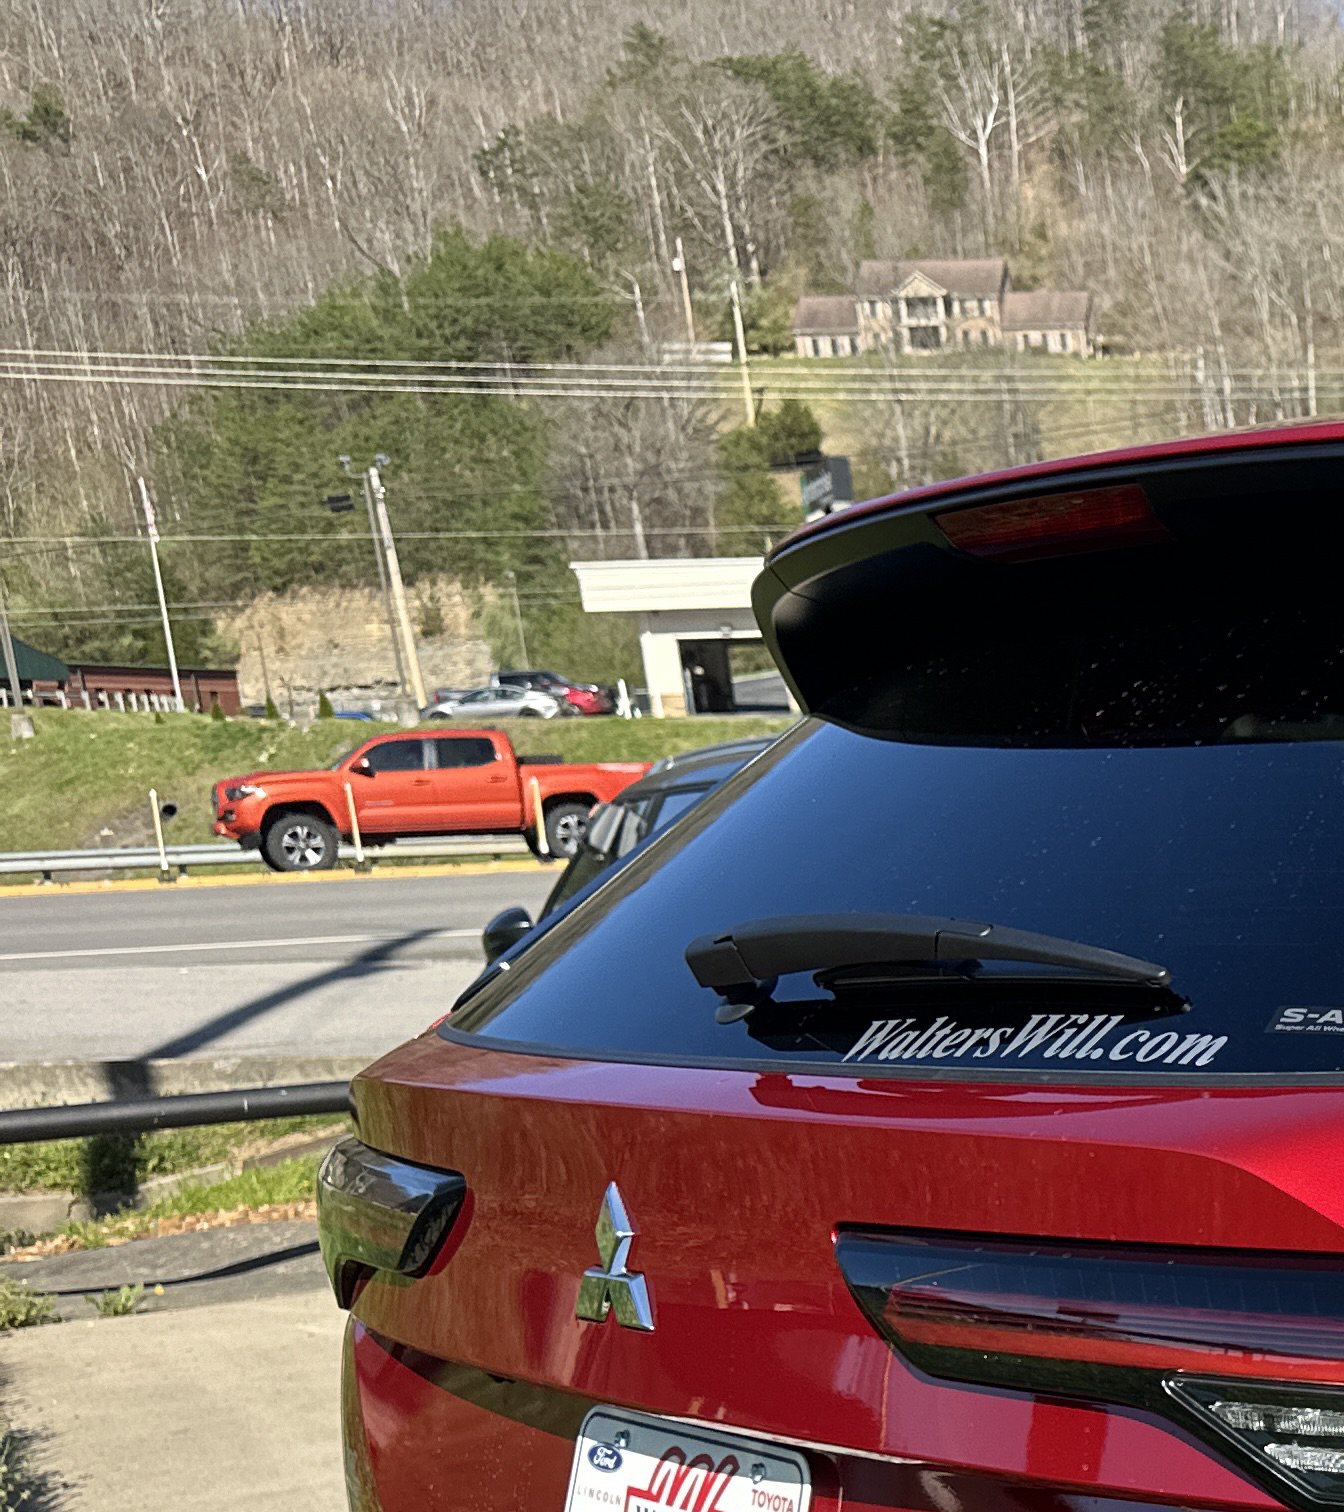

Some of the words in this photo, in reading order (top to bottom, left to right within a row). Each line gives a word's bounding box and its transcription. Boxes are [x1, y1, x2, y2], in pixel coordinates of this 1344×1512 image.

[1275, 1023, 1305, 1032] Super
[1306, 1024, 1322, 1032] All
[842, 1013, 1228, 1067] WaltersWill.com
[592, 1445, 618, 1470] Ford
[577, 1483, 621, 1506] LINCOLN
